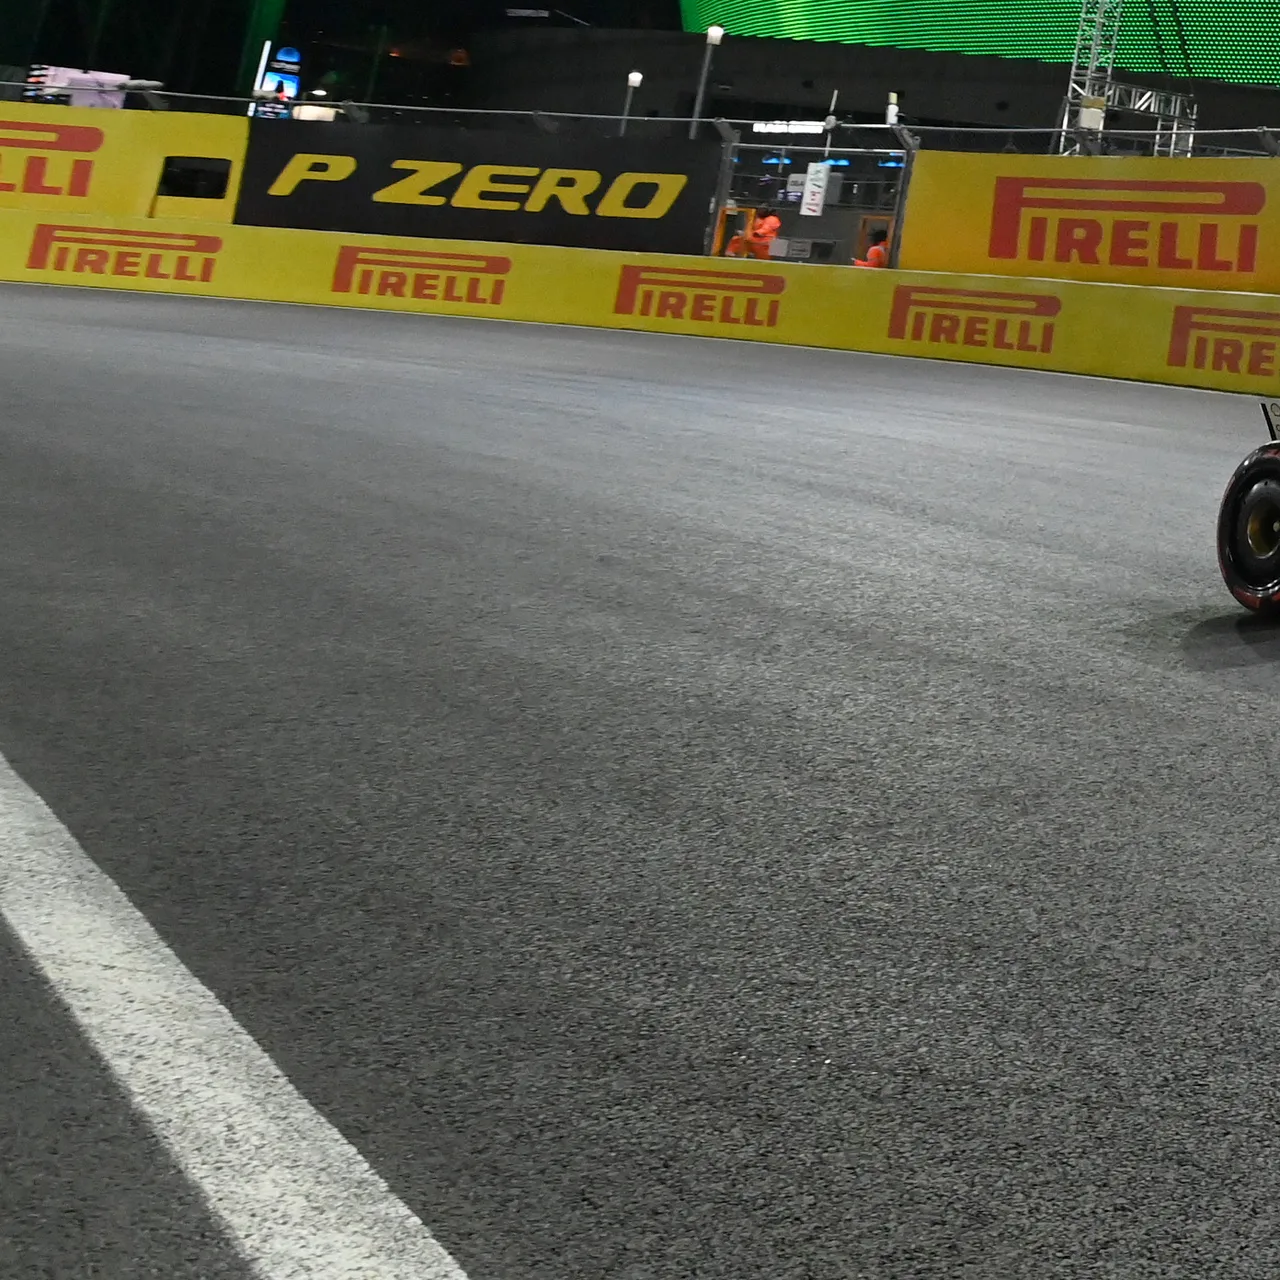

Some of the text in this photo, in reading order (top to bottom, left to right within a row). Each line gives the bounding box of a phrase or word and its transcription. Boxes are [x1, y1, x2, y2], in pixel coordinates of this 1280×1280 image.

[267, 153, 688, 220] P ZERO
[27, 223, 223, 282] PIRELLI
[988, 176, 1266, 274] PIRELLI
[332, 245, 512, 305] PIRELLI
[614, 264, 787, 327] PIRELLI
[887, 285, 1062, 353] PIRELLI
